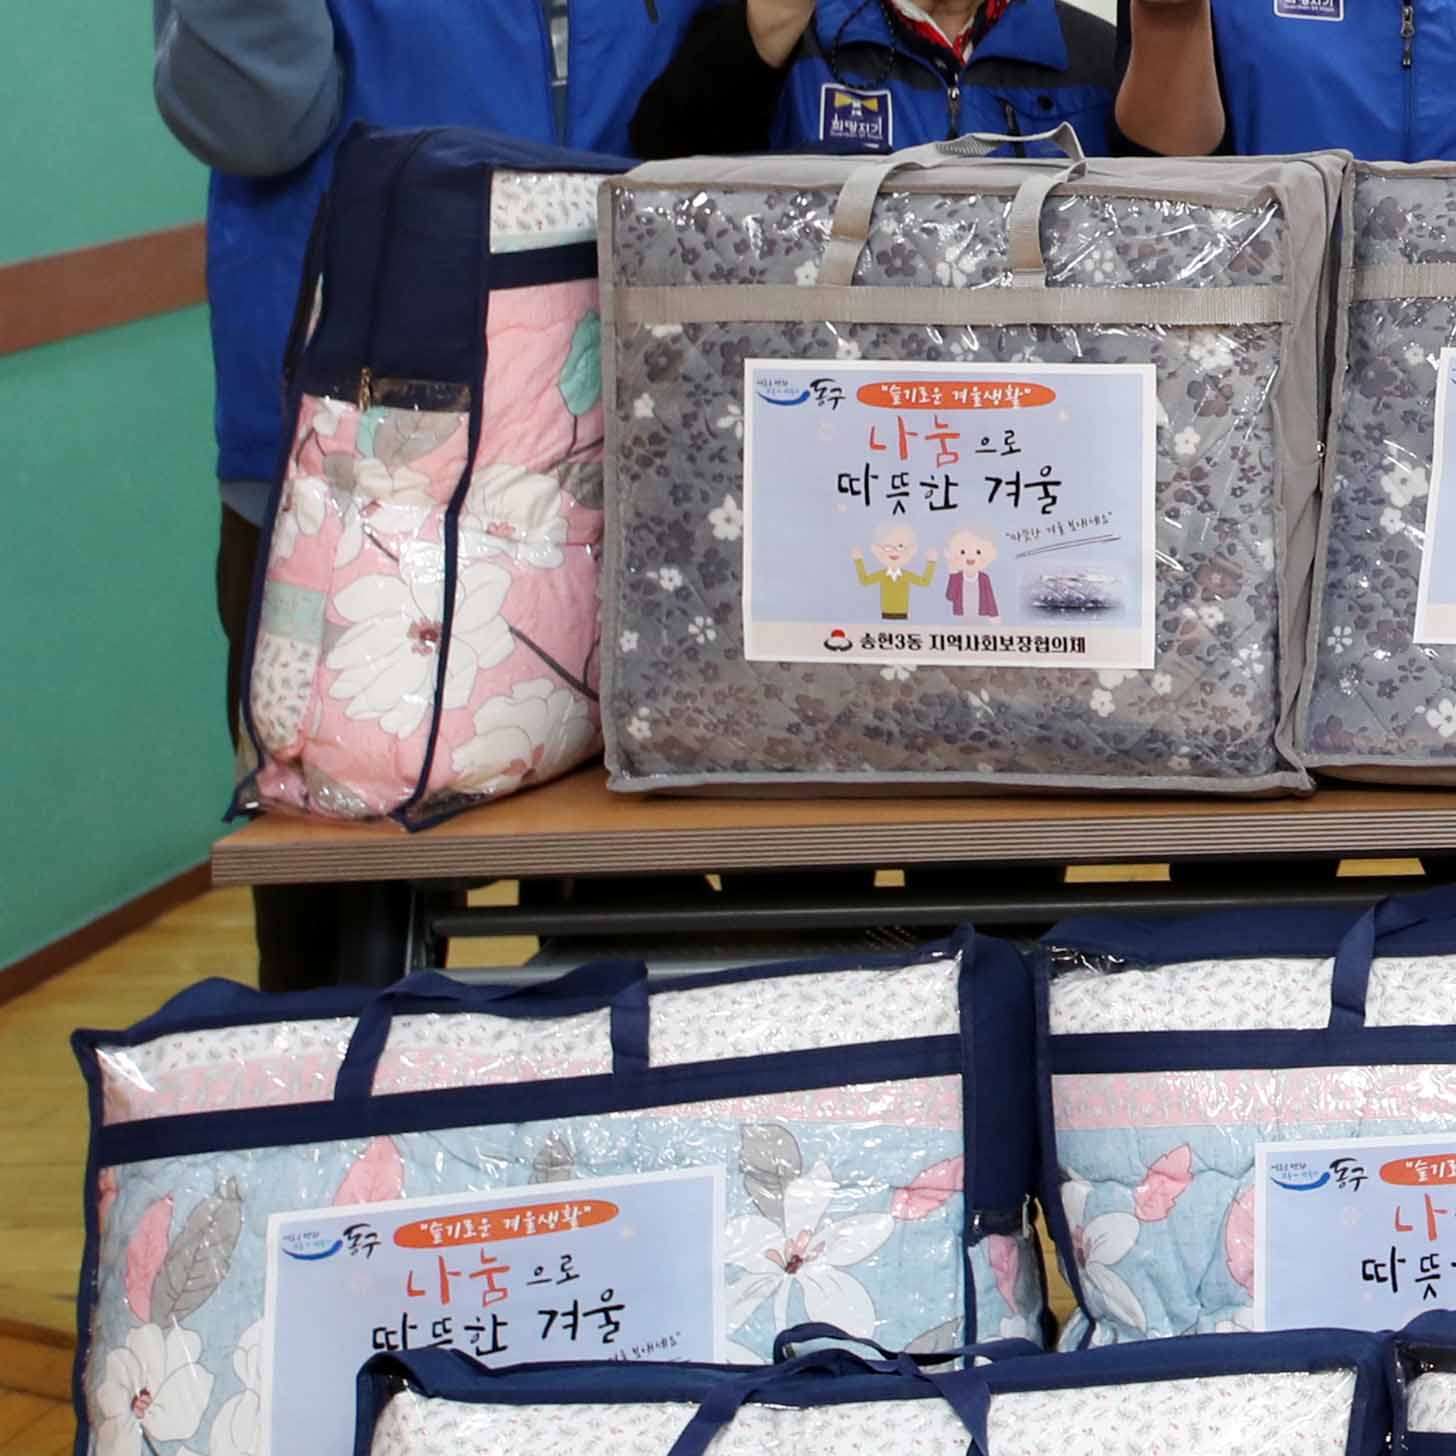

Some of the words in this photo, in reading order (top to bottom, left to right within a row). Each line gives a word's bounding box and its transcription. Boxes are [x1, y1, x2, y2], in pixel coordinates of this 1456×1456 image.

[809, 378, 846, 410] 동구
[838, 463, 958, 515] 따뜻한
[985, 465, 1062, 515] 겨울
[859, 632, 921, 652] 송현3동
[929, 633, 1086, 654] 지역사회보장협의체
[1328, 1156, 1368, 1192] 동구
[342, 1223, 381, 1258] 동구
[538, 1289, 625, 1344] 겨울
